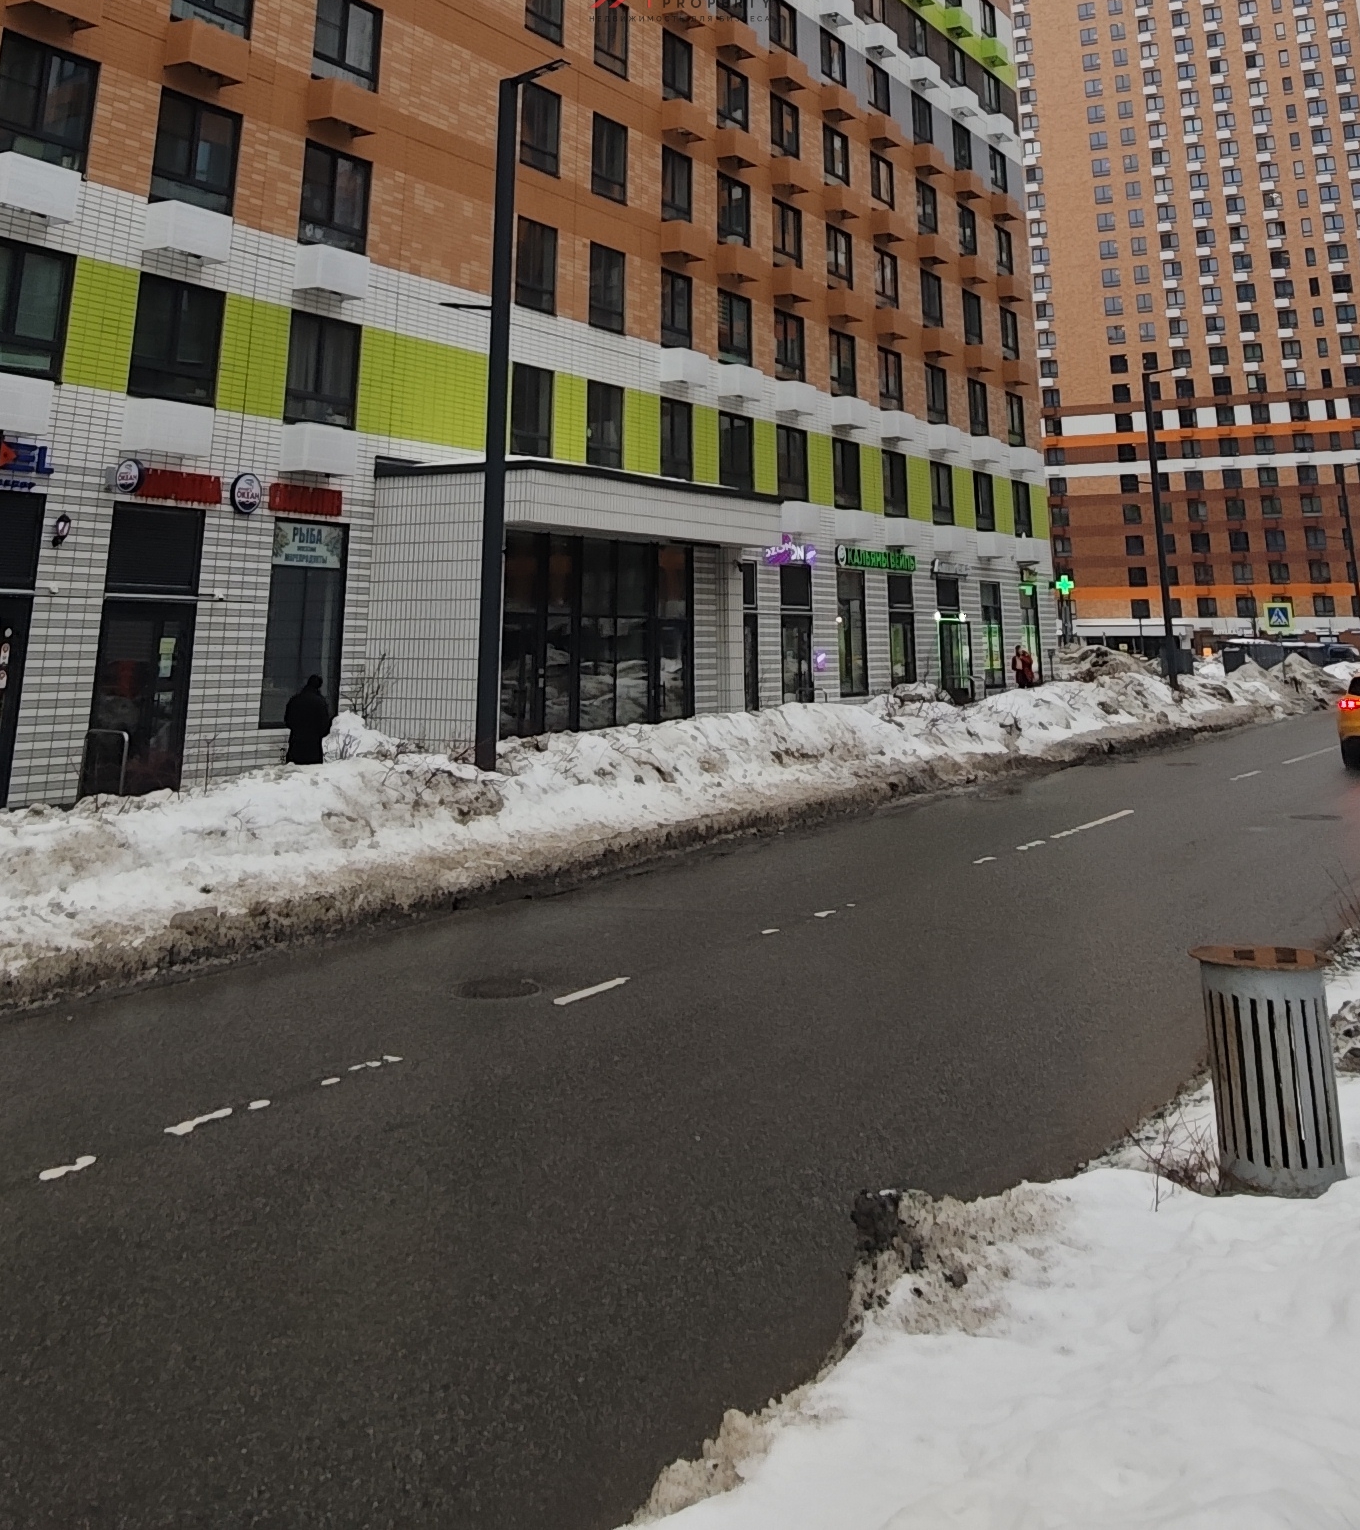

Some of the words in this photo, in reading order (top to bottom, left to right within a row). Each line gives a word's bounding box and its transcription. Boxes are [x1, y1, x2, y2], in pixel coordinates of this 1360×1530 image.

[237, 490, 260, 500] ОКЕАН
[292, 526, 323, 544] РЫБА
[847, 548, 889, 568] КАЛЬЯНЫ
